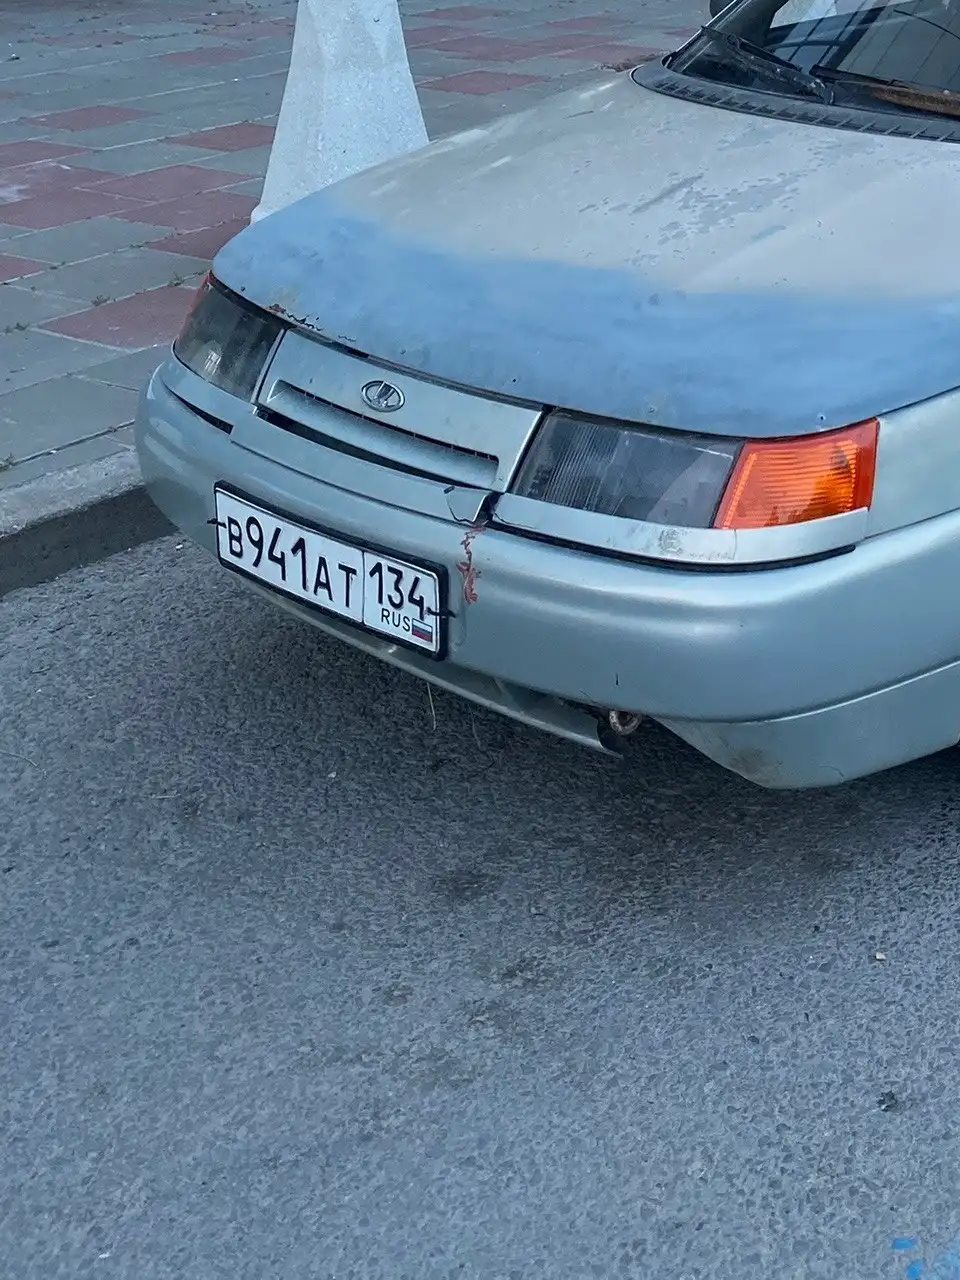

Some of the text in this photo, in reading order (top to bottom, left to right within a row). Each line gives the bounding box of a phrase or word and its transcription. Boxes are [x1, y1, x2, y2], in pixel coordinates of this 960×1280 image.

[227, 516, 430, 621] В941АТ 134
[381, 607, 411, 632] RUS
